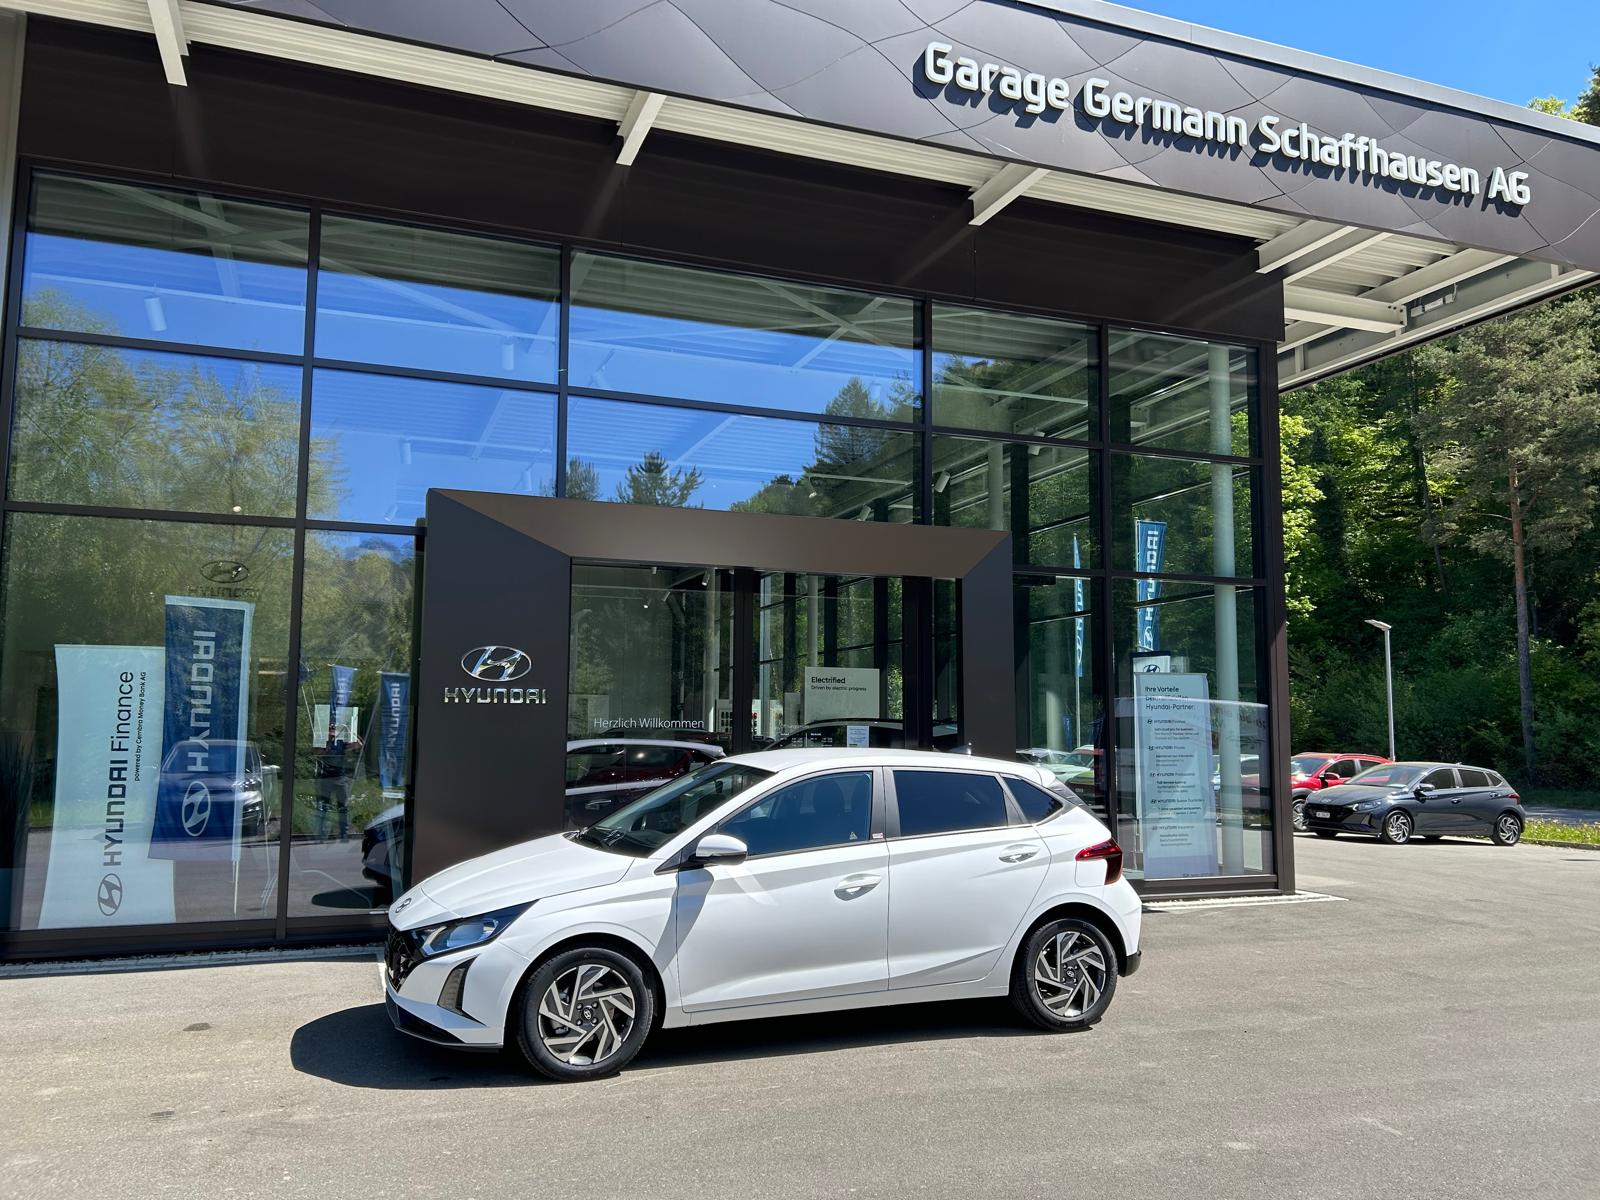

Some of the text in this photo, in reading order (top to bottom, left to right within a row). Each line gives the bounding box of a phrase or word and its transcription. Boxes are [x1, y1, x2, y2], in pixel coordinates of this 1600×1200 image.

[925, 41, 1531, 205] Garage Germann Schaffhausen AG
[140, 671, 147, 681] AG
[811, 676, 846, 684] Electrified
[444, 687, 546, 704] HYUNDAI
[137, 697, 145, 719] Money
[386, 683, 400, 747] HYUNDAI
[593, 717, 705, 729] Herzlich Willkommen
[136, 745, 142, 754] by
[103, 671, 134, 867] HYUNDAI Finance
